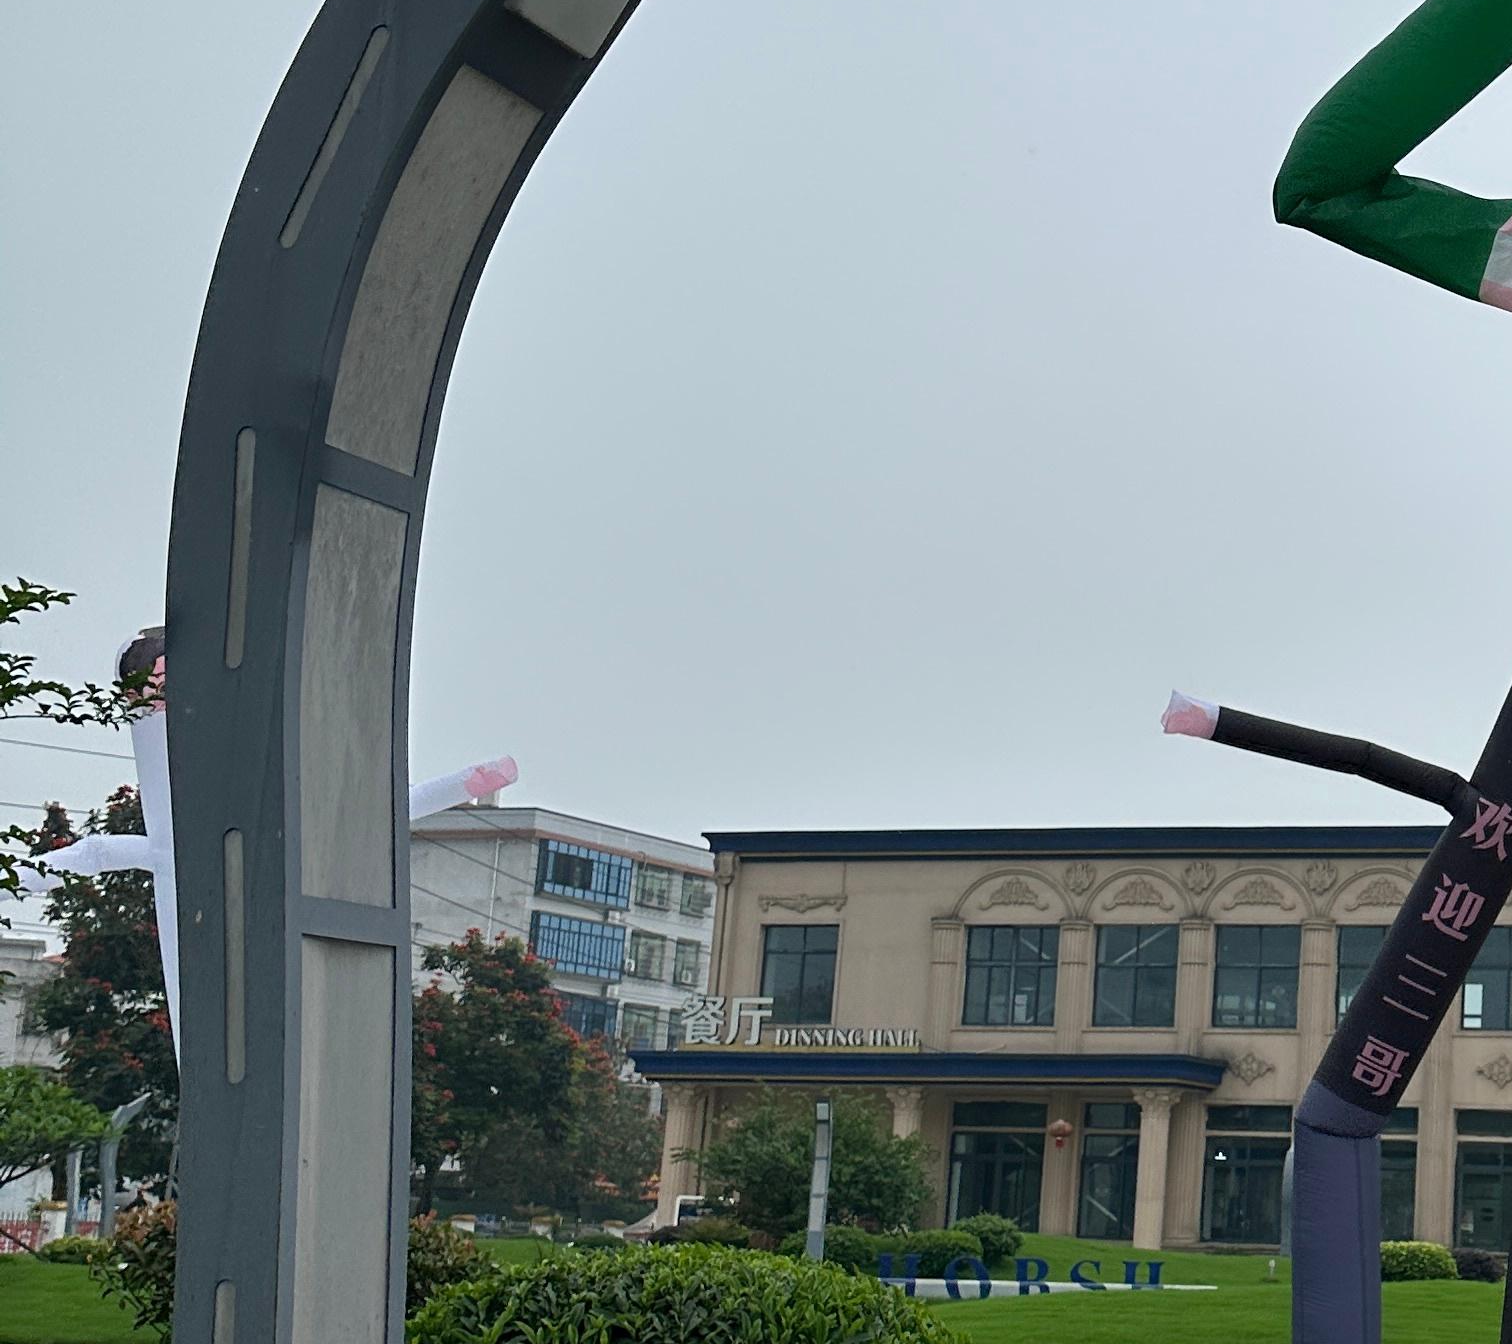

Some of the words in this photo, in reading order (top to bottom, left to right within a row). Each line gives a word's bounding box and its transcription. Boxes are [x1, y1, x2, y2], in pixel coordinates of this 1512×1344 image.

[680, 994, 774, 1046] 餐厅
[775, 1028, 864, 1047] DINNING
[868, 1029, 921, 1048] HALL
[877, 1252, 1165, 1299] HORSH
